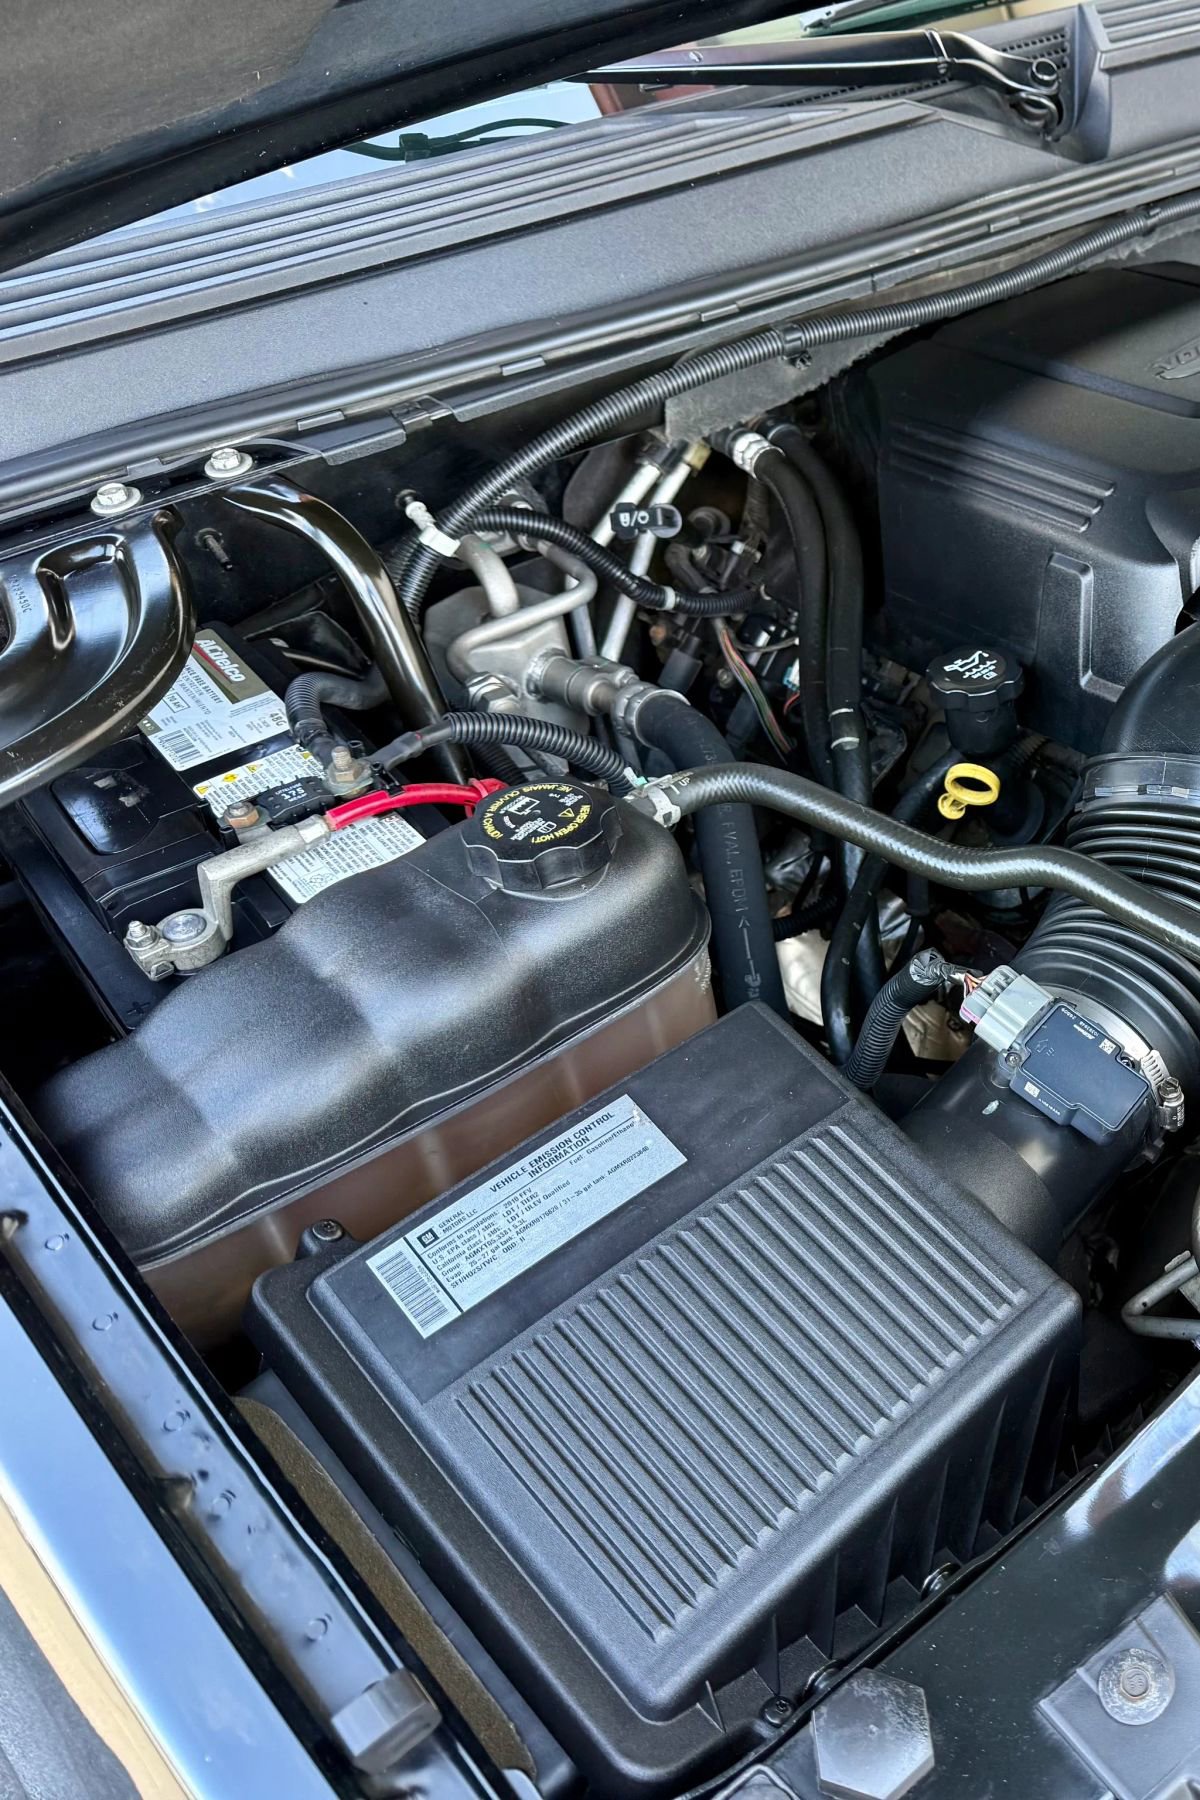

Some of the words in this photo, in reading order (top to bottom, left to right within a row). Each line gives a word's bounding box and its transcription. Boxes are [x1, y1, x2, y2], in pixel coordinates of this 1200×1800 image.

[195, 638, 246, 681] ACDelco
[201, 684, 223, 704] BATTERY
[280, 786, 305, 800] 175
[522, 784, 558, 792] JAMAIS
[676, 777, 690, 787] UP
[530, 833, 553, 843] HOT!
[552, 822, 578, 838] OPEN
[489, 1166, 528, 1193] VEHICLE
[528, 1137, 573, 1168] EMISSION
[572, 1112, 615, 1140] CONTROL
[528, 1135, 590, 1178] INFORMATION
[427, 1238, 457, 1260] Conforms
[464, 1209, 500, 1235] regulations:
[518, 1187, 532, 1199] FFV
[431, 1254, 445, 1265] U.S.
[446, 1244, 461, 1255] EPA
[460, 1233, 478, 1247] class
[481, 1220, 497, 1232] stds:
[502, 1206, 516, 1218] LDT
[520, 1191, 539, 1206] TIER2
[436, 1249, 467, 1271] California
[466, 1238, 483, 1252] class
[487, 1225, 503, 1238] stds:
[506, 1212, 520, 1224] LDT
[524, 1198, 542, 1212] ULEV
[542, 1179, 571, 1201] Qualified
[438, 1210, 465, 1229] GENERAL
[442, 1215, 467, 1234] MOTORS
[465, 1208, 478, 1218] LLC
[445, 1269, 464, 1283] Evap:
[490, 1244, 501, 1254] gal
[499, 1234, 516, 1247] tank:
[582, 1182, 593, 1192] gal
